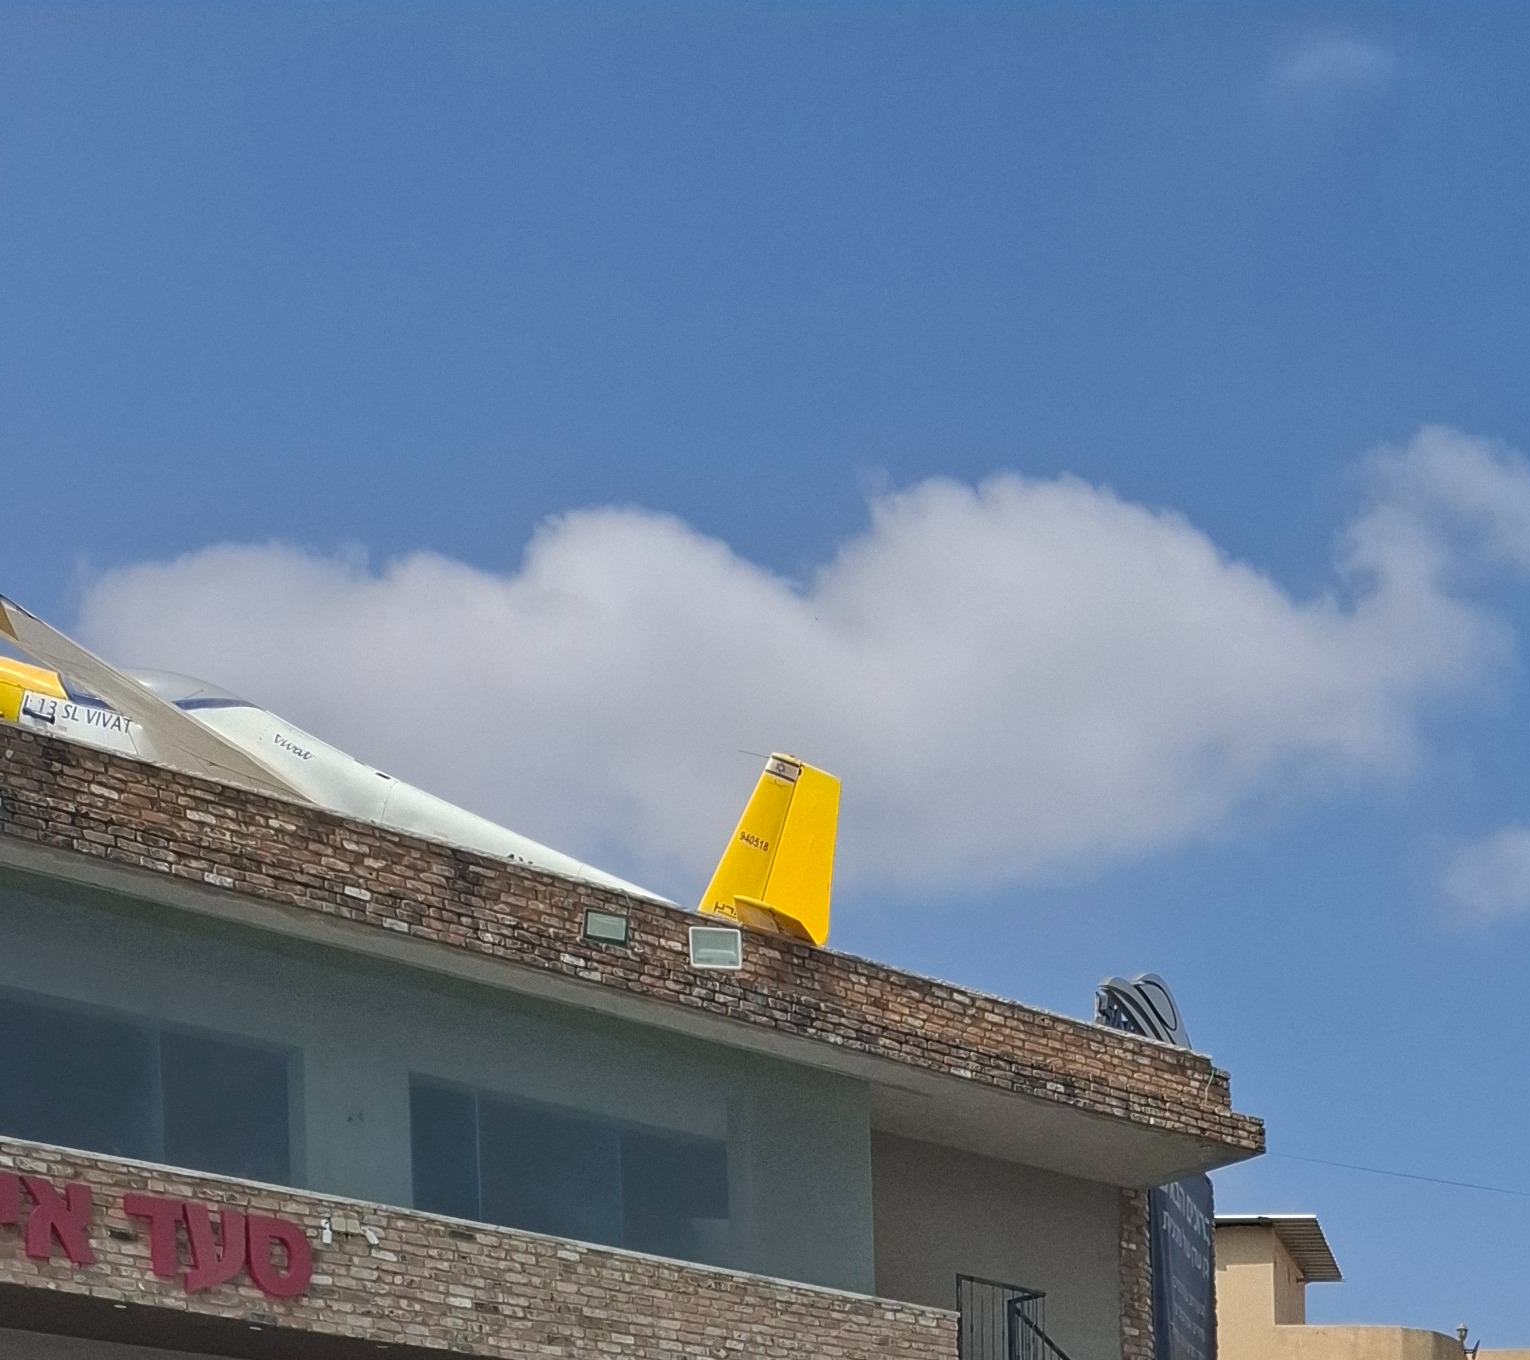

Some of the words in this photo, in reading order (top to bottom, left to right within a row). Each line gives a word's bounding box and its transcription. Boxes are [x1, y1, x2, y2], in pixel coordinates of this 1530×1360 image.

[39, 698, 57, 715] 13
[61, 704, 80, 722] SL
[86, 708, 134, 733] VIVAT
[123, 1193, 313, 1297] סעד
